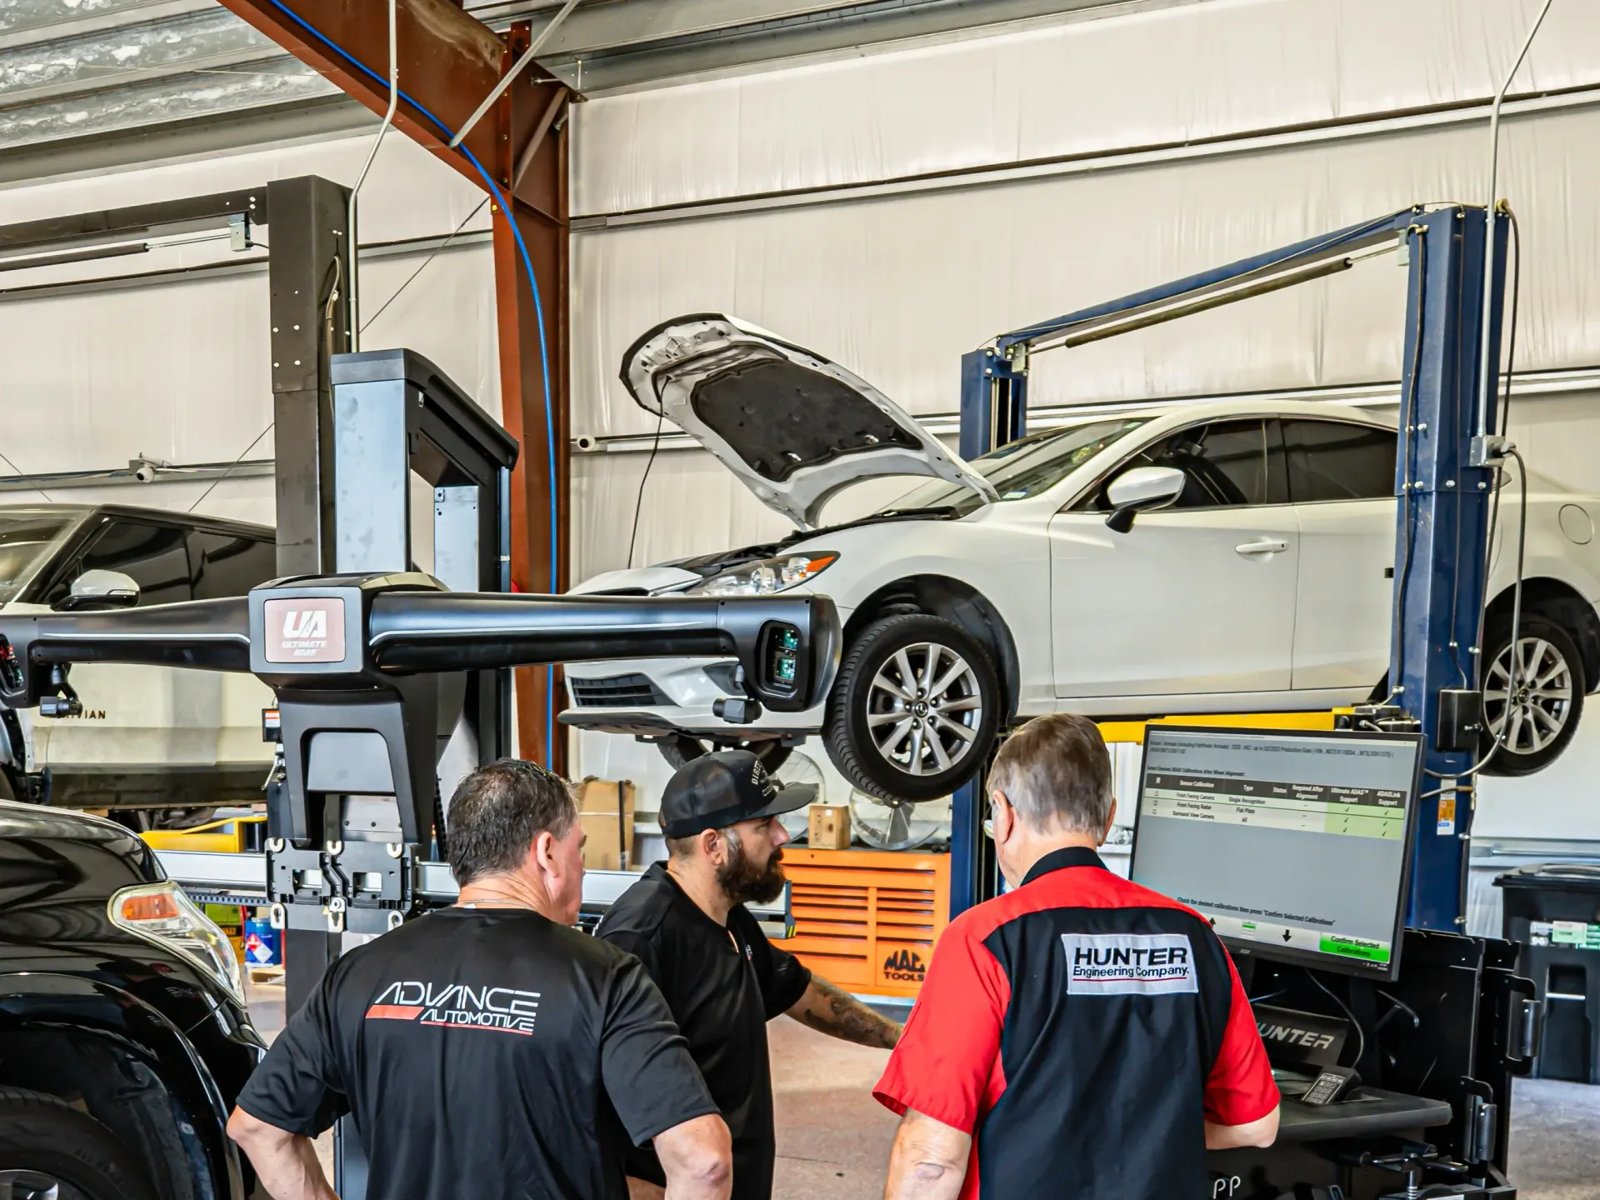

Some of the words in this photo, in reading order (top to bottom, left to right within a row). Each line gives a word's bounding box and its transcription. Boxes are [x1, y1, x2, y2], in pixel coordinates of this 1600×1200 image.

[283, 610, 328, 639] UA
[1331, 936, 1353, 944] Confirm
[1355, 940, 1379, 949] Selected
[884, 949, 926, 973] MAC
[1074, 947, 1188, 966] HUNTER
[884, 972, 925, 982] TOOLS
[1073, 966, 1134, 978] Engineering
[1136, 966, 1189, 978] Company.
[375, 981, 540, 1017] ADVANCE
[420, 1008, 536, 1032] AUTOMOTIVE
[1257, 1022, 1335, 1049] UNTER
